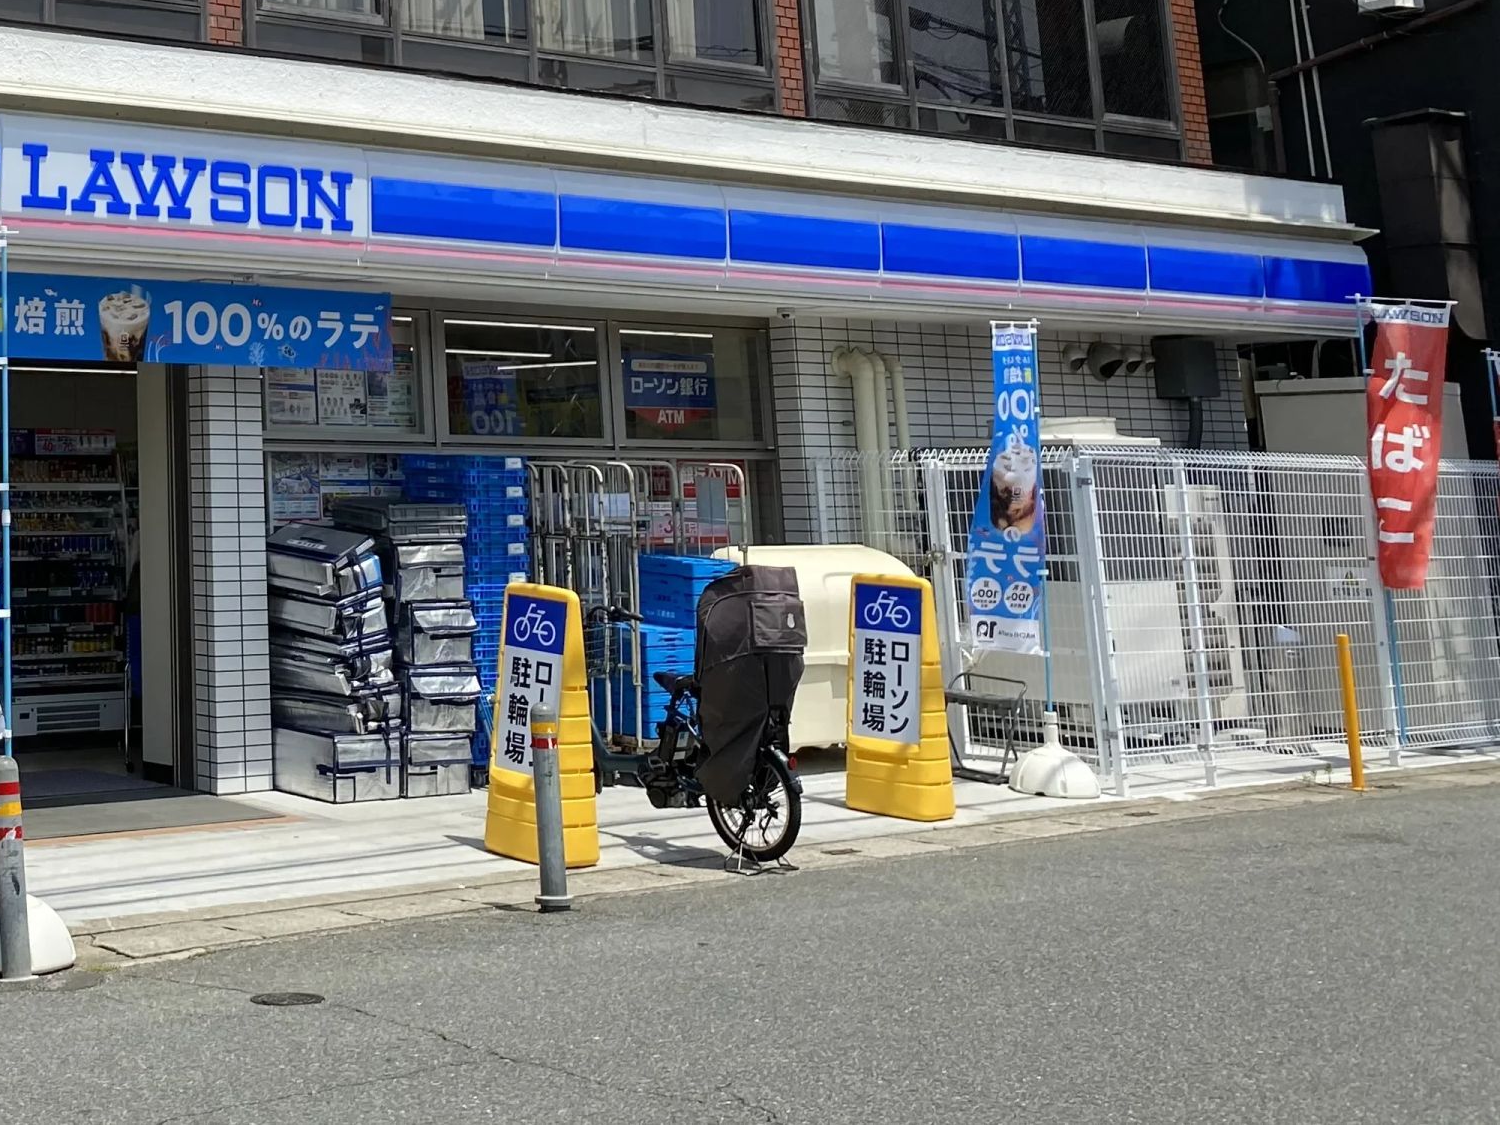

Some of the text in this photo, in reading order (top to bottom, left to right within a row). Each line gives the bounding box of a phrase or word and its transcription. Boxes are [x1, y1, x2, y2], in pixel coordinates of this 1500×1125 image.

[21, 143, 353, 231] LAWSON
[630, 377, 708, 396] ローソン銀行
[657, 409, 685, 424] ATM
[1371, 352, 1430, 544] たばこ
[505, 656, 532, 764] 駐輪場
[862, 638, 887, 732] 駐輪場
[890, 640, 909, 734] ローソン
